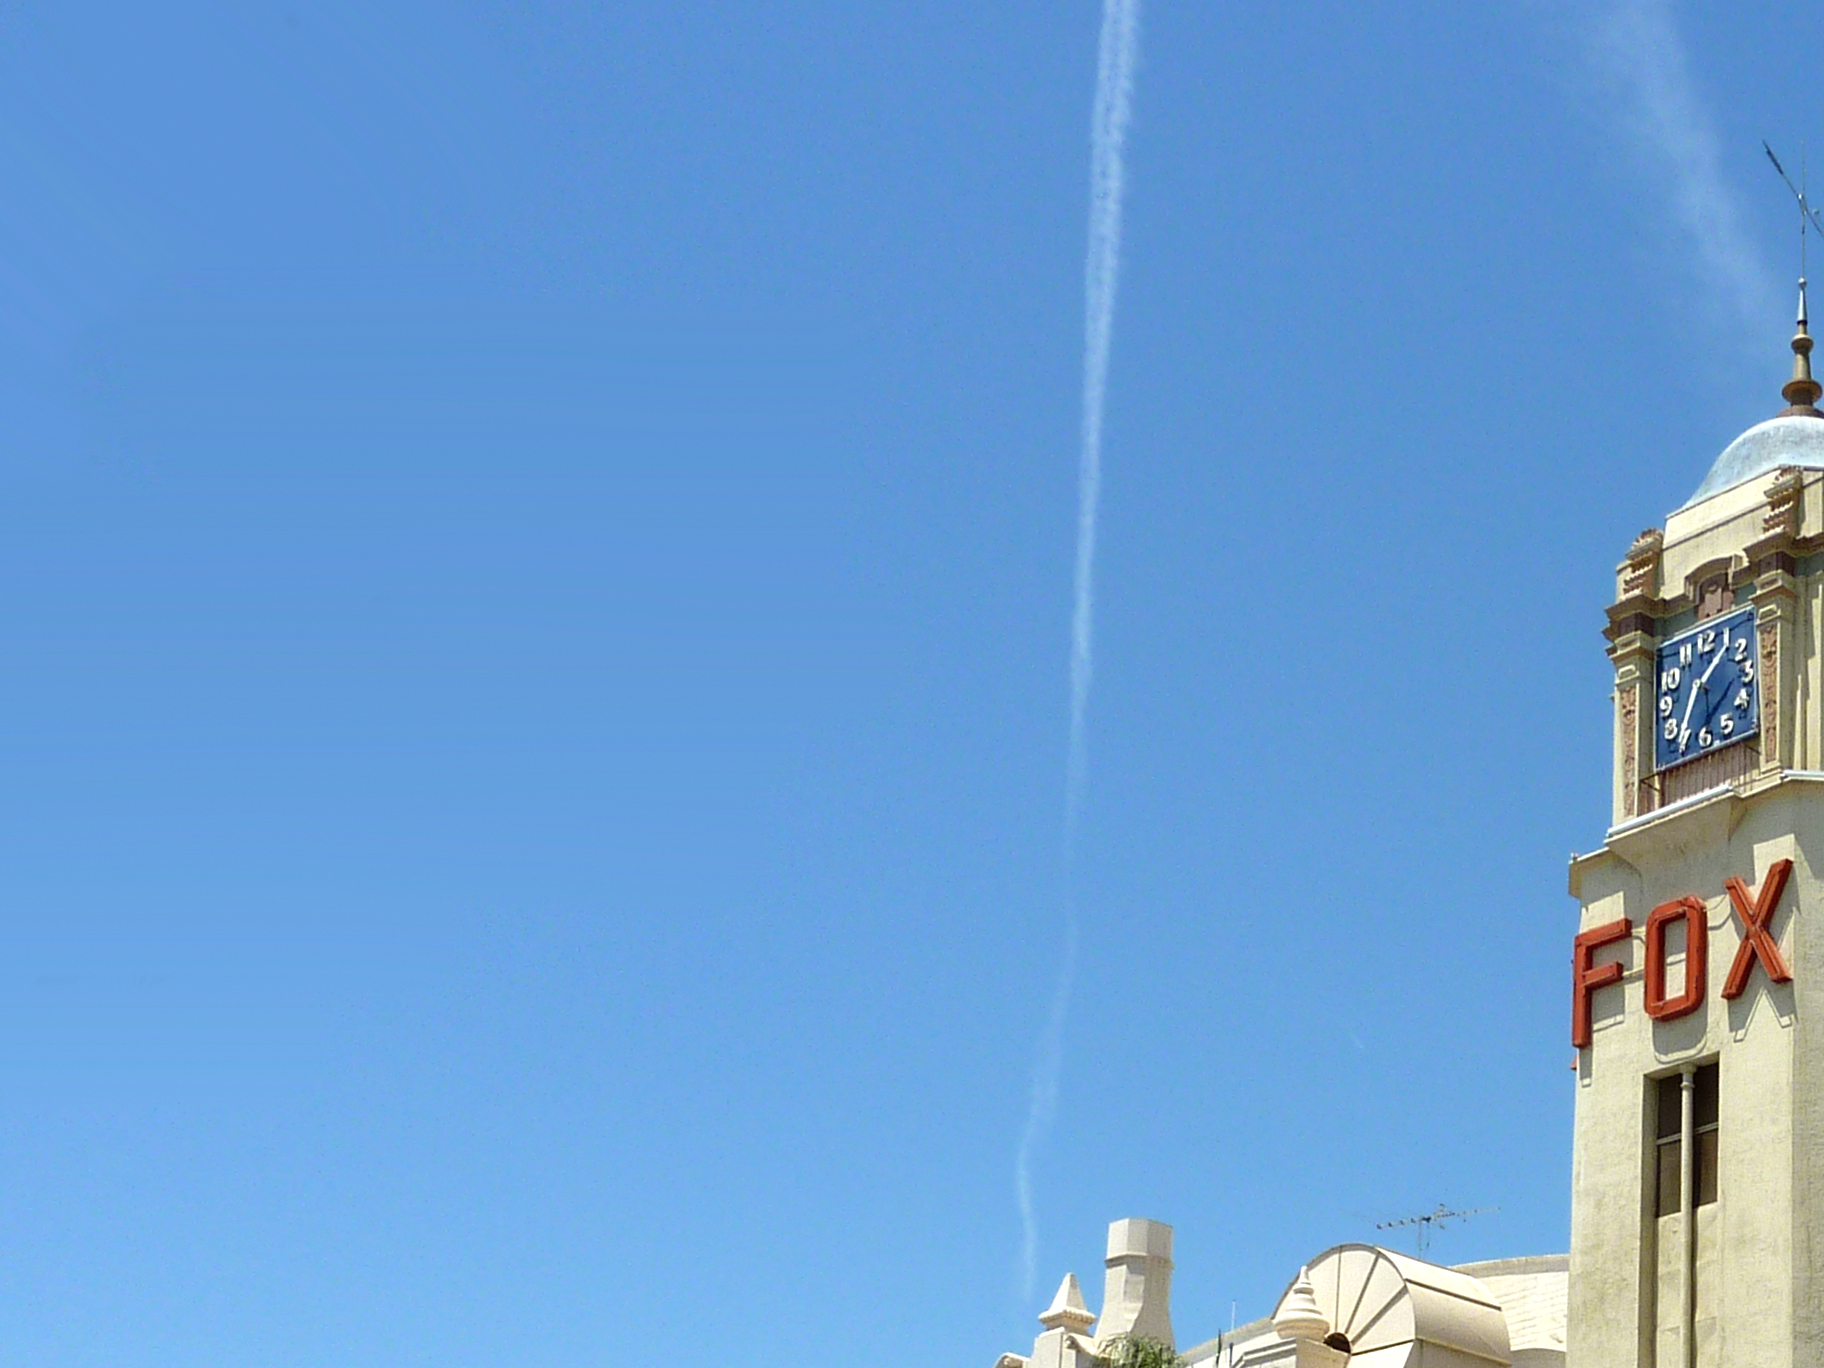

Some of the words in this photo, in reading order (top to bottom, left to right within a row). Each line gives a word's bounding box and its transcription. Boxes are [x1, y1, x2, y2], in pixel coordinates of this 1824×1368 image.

[1698, 630, 1715, 654] 12
[1723, 627, 1730, 646] 1
[1680, 643, 1692, 666] 11
[1735, 638, 1747, 661] 2
[1662, 668, 1680, 692] 10
[1742, 660, 1753, 683] 3
[1659, 696, 1673, 717] 9
[1734, 688, 1749, 709] 4
[1664, 718, 1678, 740] 8
[1721, 713, 1733, 735] 5
[1699, 726, 1712, 747] 6
[1572, 858, 1793, 1049] FOX
